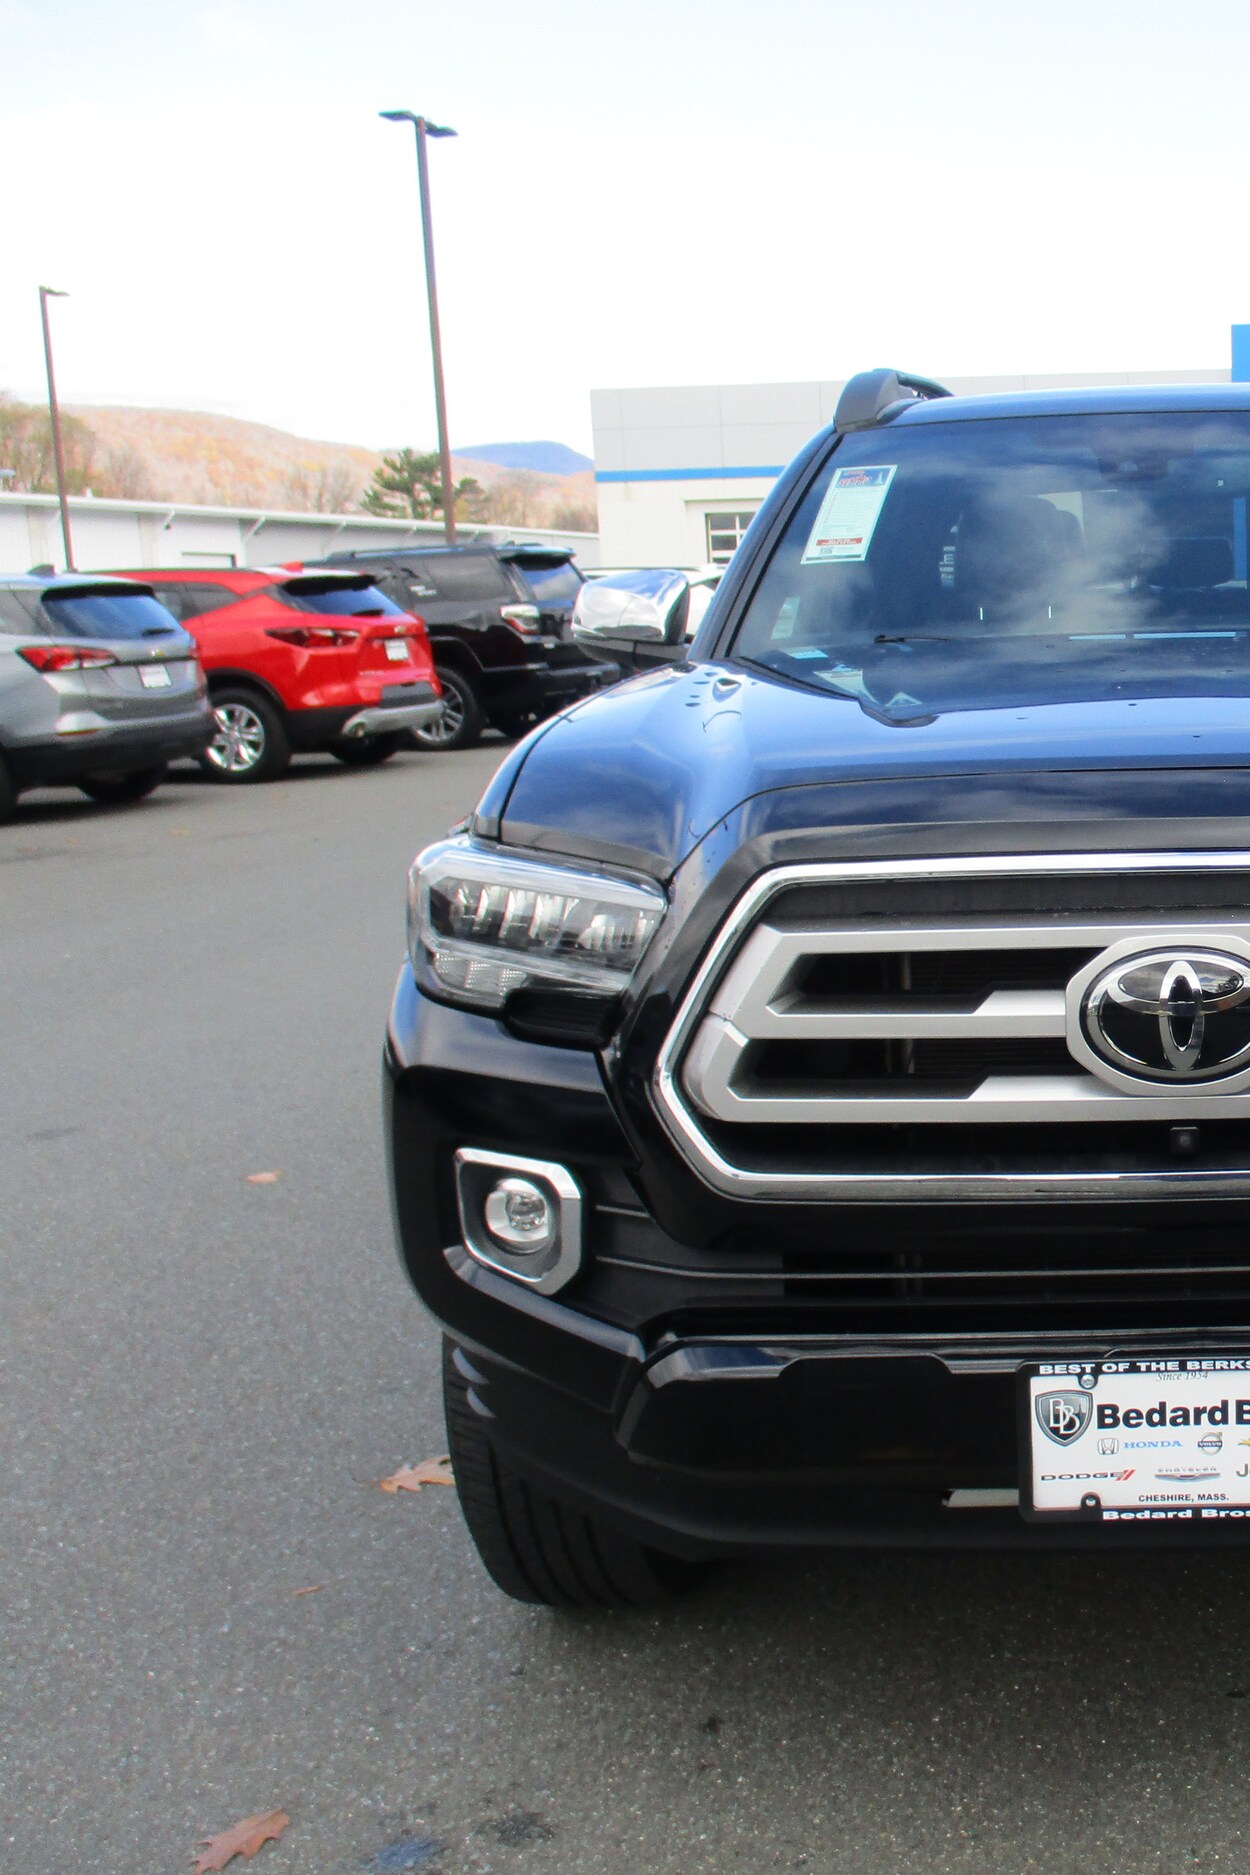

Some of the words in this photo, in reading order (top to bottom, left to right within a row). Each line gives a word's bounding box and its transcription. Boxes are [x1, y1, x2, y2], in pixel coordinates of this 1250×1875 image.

[1039, 1363, 1096, 1375] BEST
[1101, 1362, 1131, 1374] OF
[1136, 1361, 1181, 1373] THE
[1096, 1400, 1229, 1430] Bedard
[1123, 1439, 1183, 1449] HONDA
[1198, 1440, 1222, 1448] VOLVO
[1040, 1471, 1123, 1482] DODGE
[1138, 1494, 1195, 1503] CHESHIRE,
[1197, 1492, 1230, 1502] MASS.
[1103, 1508, 1192, 1521] Bedard
